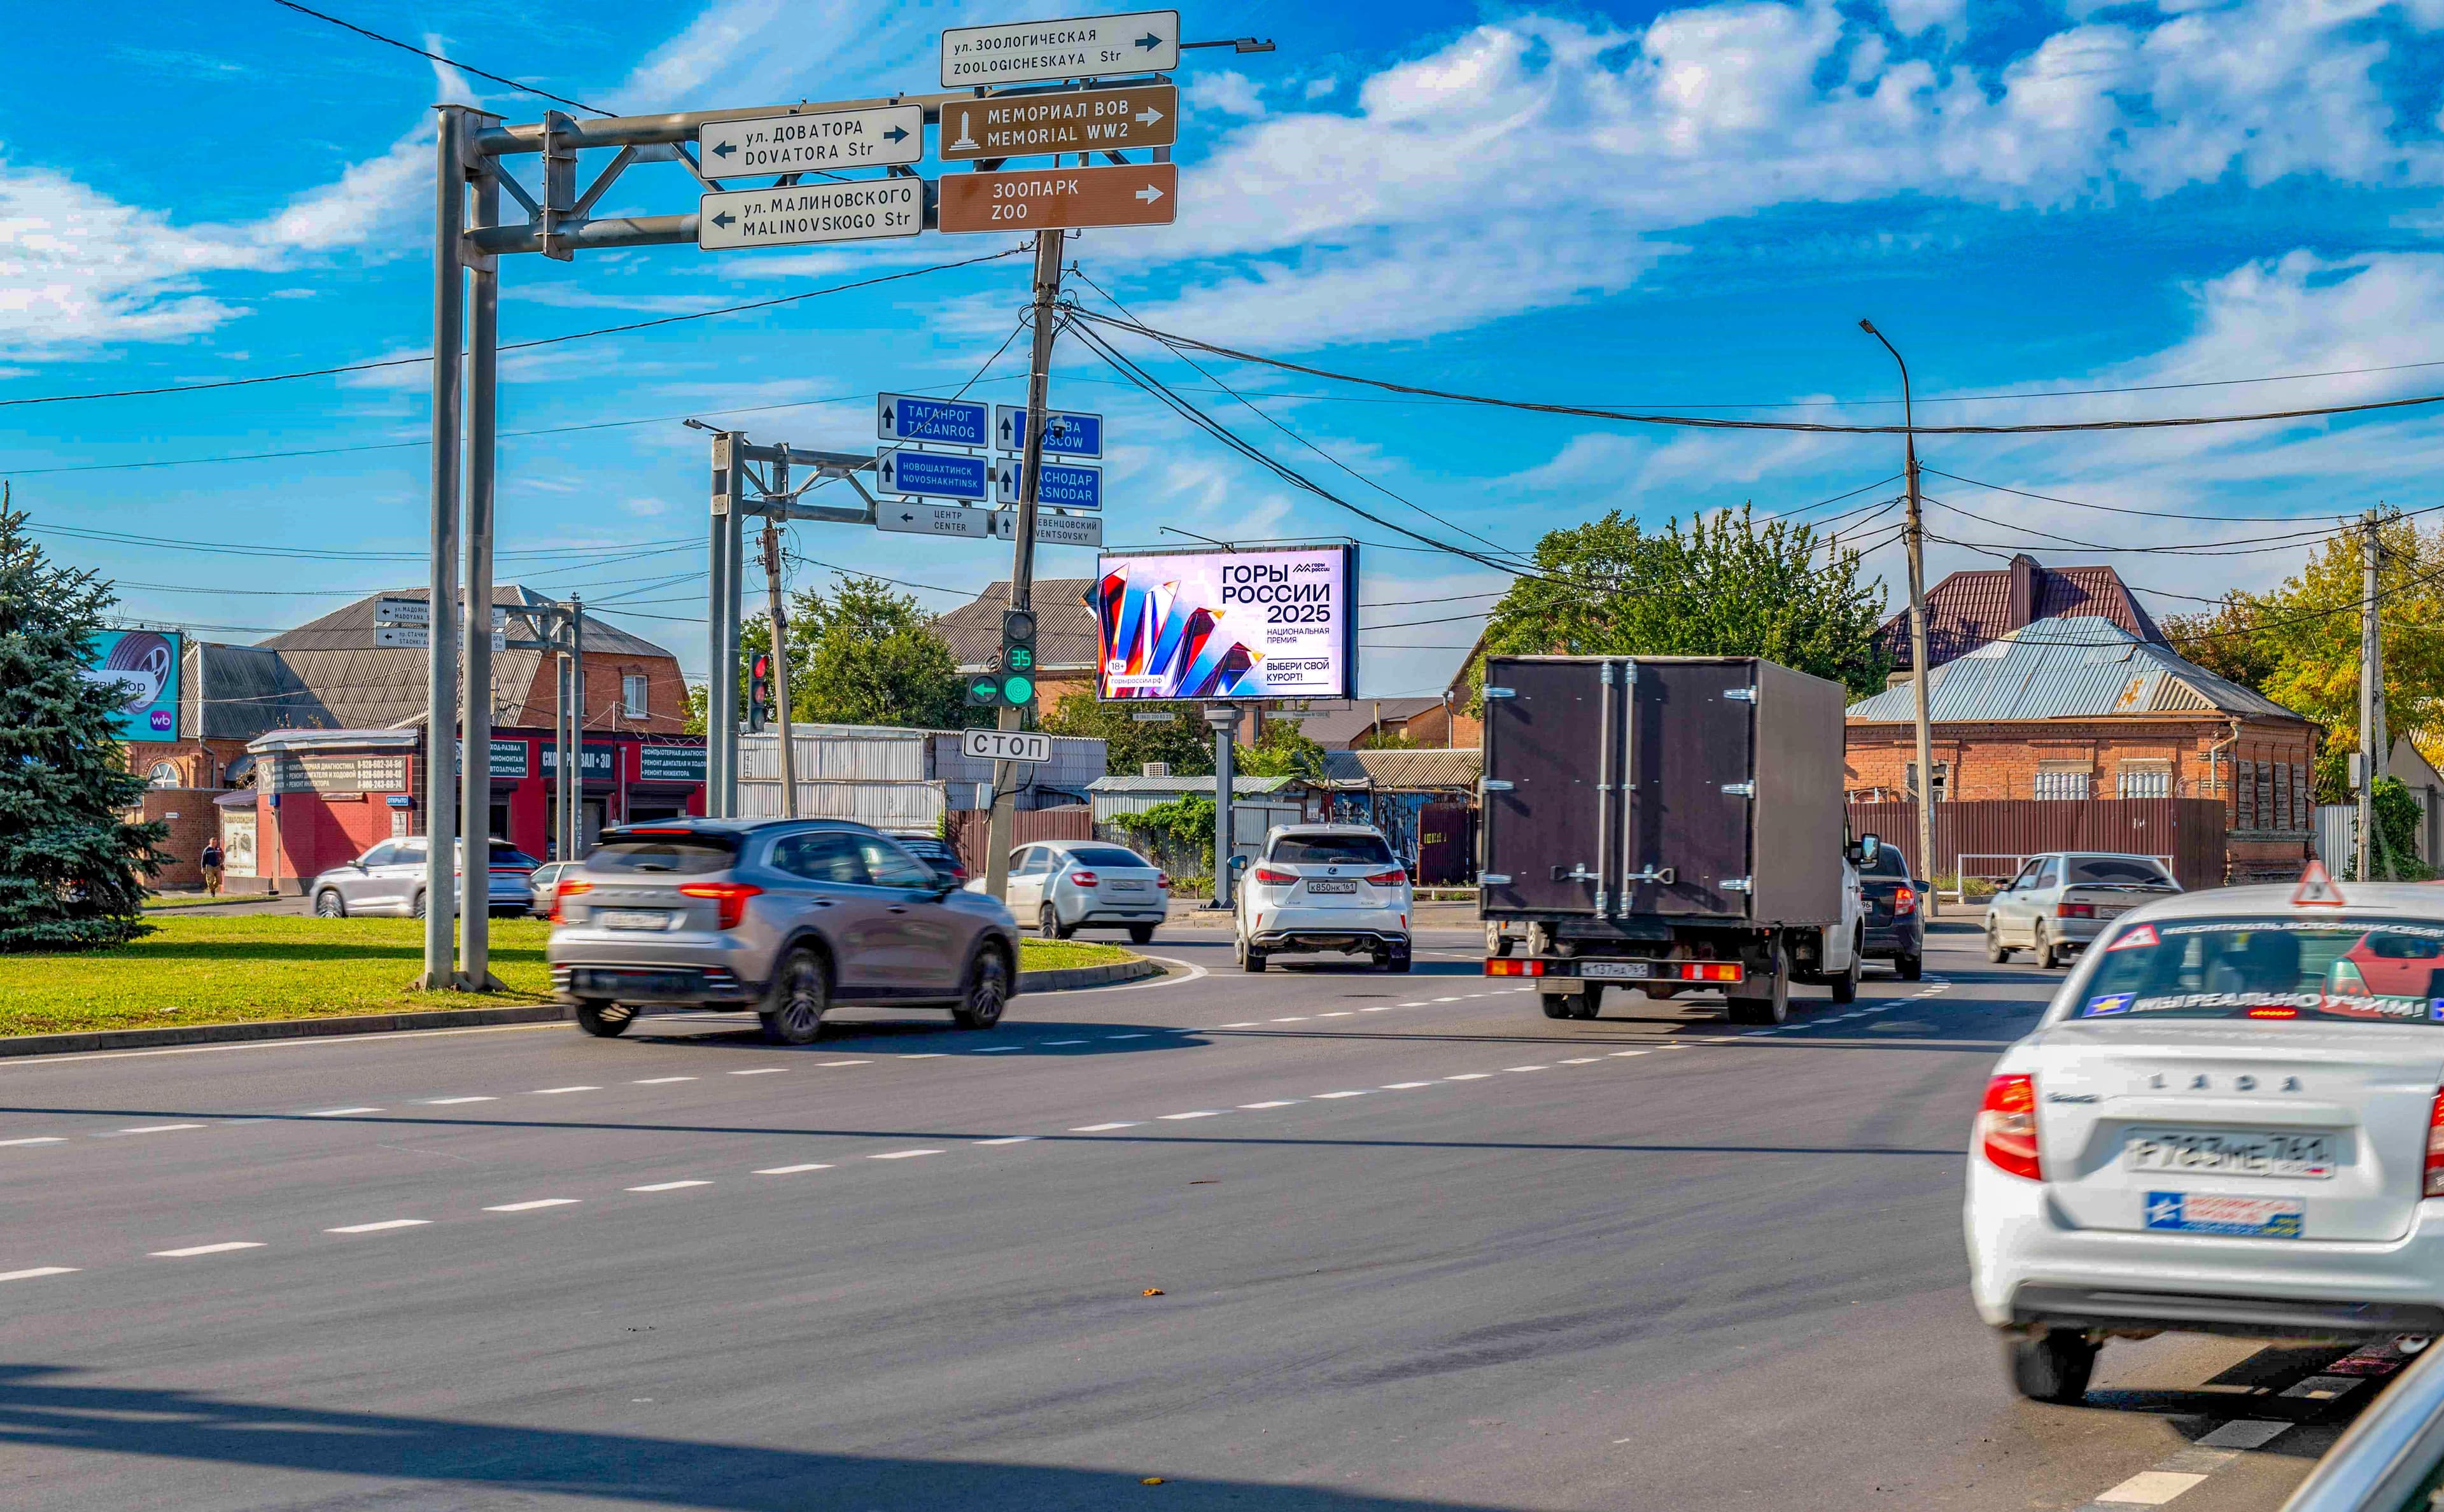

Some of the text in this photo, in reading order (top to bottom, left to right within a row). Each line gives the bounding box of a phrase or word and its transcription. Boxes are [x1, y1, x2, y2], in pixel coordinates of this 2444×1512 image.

[954, 30, 1097, 55] ул. ЗООЛОГИЧЕСКАЯ
[954, 50, 1121, 74] ZOOLOGICHESKAYA Str
[988, 100, 1128, 125] МЕМОРИАЛ ВОВ
[746, 120, 863, 147] ул. ДОВАТОРА
[988, 123, 1128, 147] MEMORIAL WW2
[746, 142, 873, 165] DOVATORA Str
[993, 179, 1079, 199] ЗООПАРК
[744, 188, 911, 218] ул. МАЛИНОВСКОГО
[992, 204, 1028, 220] ZOO
[743, 212, 910, 236] MALINOVSKOGO Str
[908, 405, 973, 422] ТАГАНРОГ
[908, 421, 974, 438] TAGANROG
[1043, 434, 1083, 448] OSCOW
[902, 462, 972, 477] НОВОШАХТИНСК
[902, 473, 978, 489] NOVOSHAKHTINSK
[1040, 472, 1093, 486] АСНОДАР
[1039, 487, 1093, 501] ASNODAR
[934, 510, 962, 521] ЦЕНТР
[934, 521, 966, 532] CENTER
[1038, 518, 1097, 530] ЕВЕНЦОВСКИЙ
[1036, 529, 1088, 540] VENTSOVSKY
[1223, 564, 1288, 584] ГОРЫ
[1223, 584, 1330, 604] РОССИИ
[1267, 605, 1330, 623] 2025
[1267, 627, 1330, 636] НАЦИОНАЛЬНАЯ
[1012, 650, 1030, 666] 35
[1267, 659, 1330, 671] ВЫБЕРИ СВОЙ
[1267, 673, 1303, 681] КУРОРТ!
[151, 715, 171, 725] wb
[974, 734, 1042, 757] СТОП
[321, 762, 355, 771] ДИАГНОСТИКА
[491, 755, 524, 763] ИНОМОНТАЖ
[2183, 991, 2322, 1007] РЕАЛЬНО
[2148, 1072, 2304, 1093] LADA
